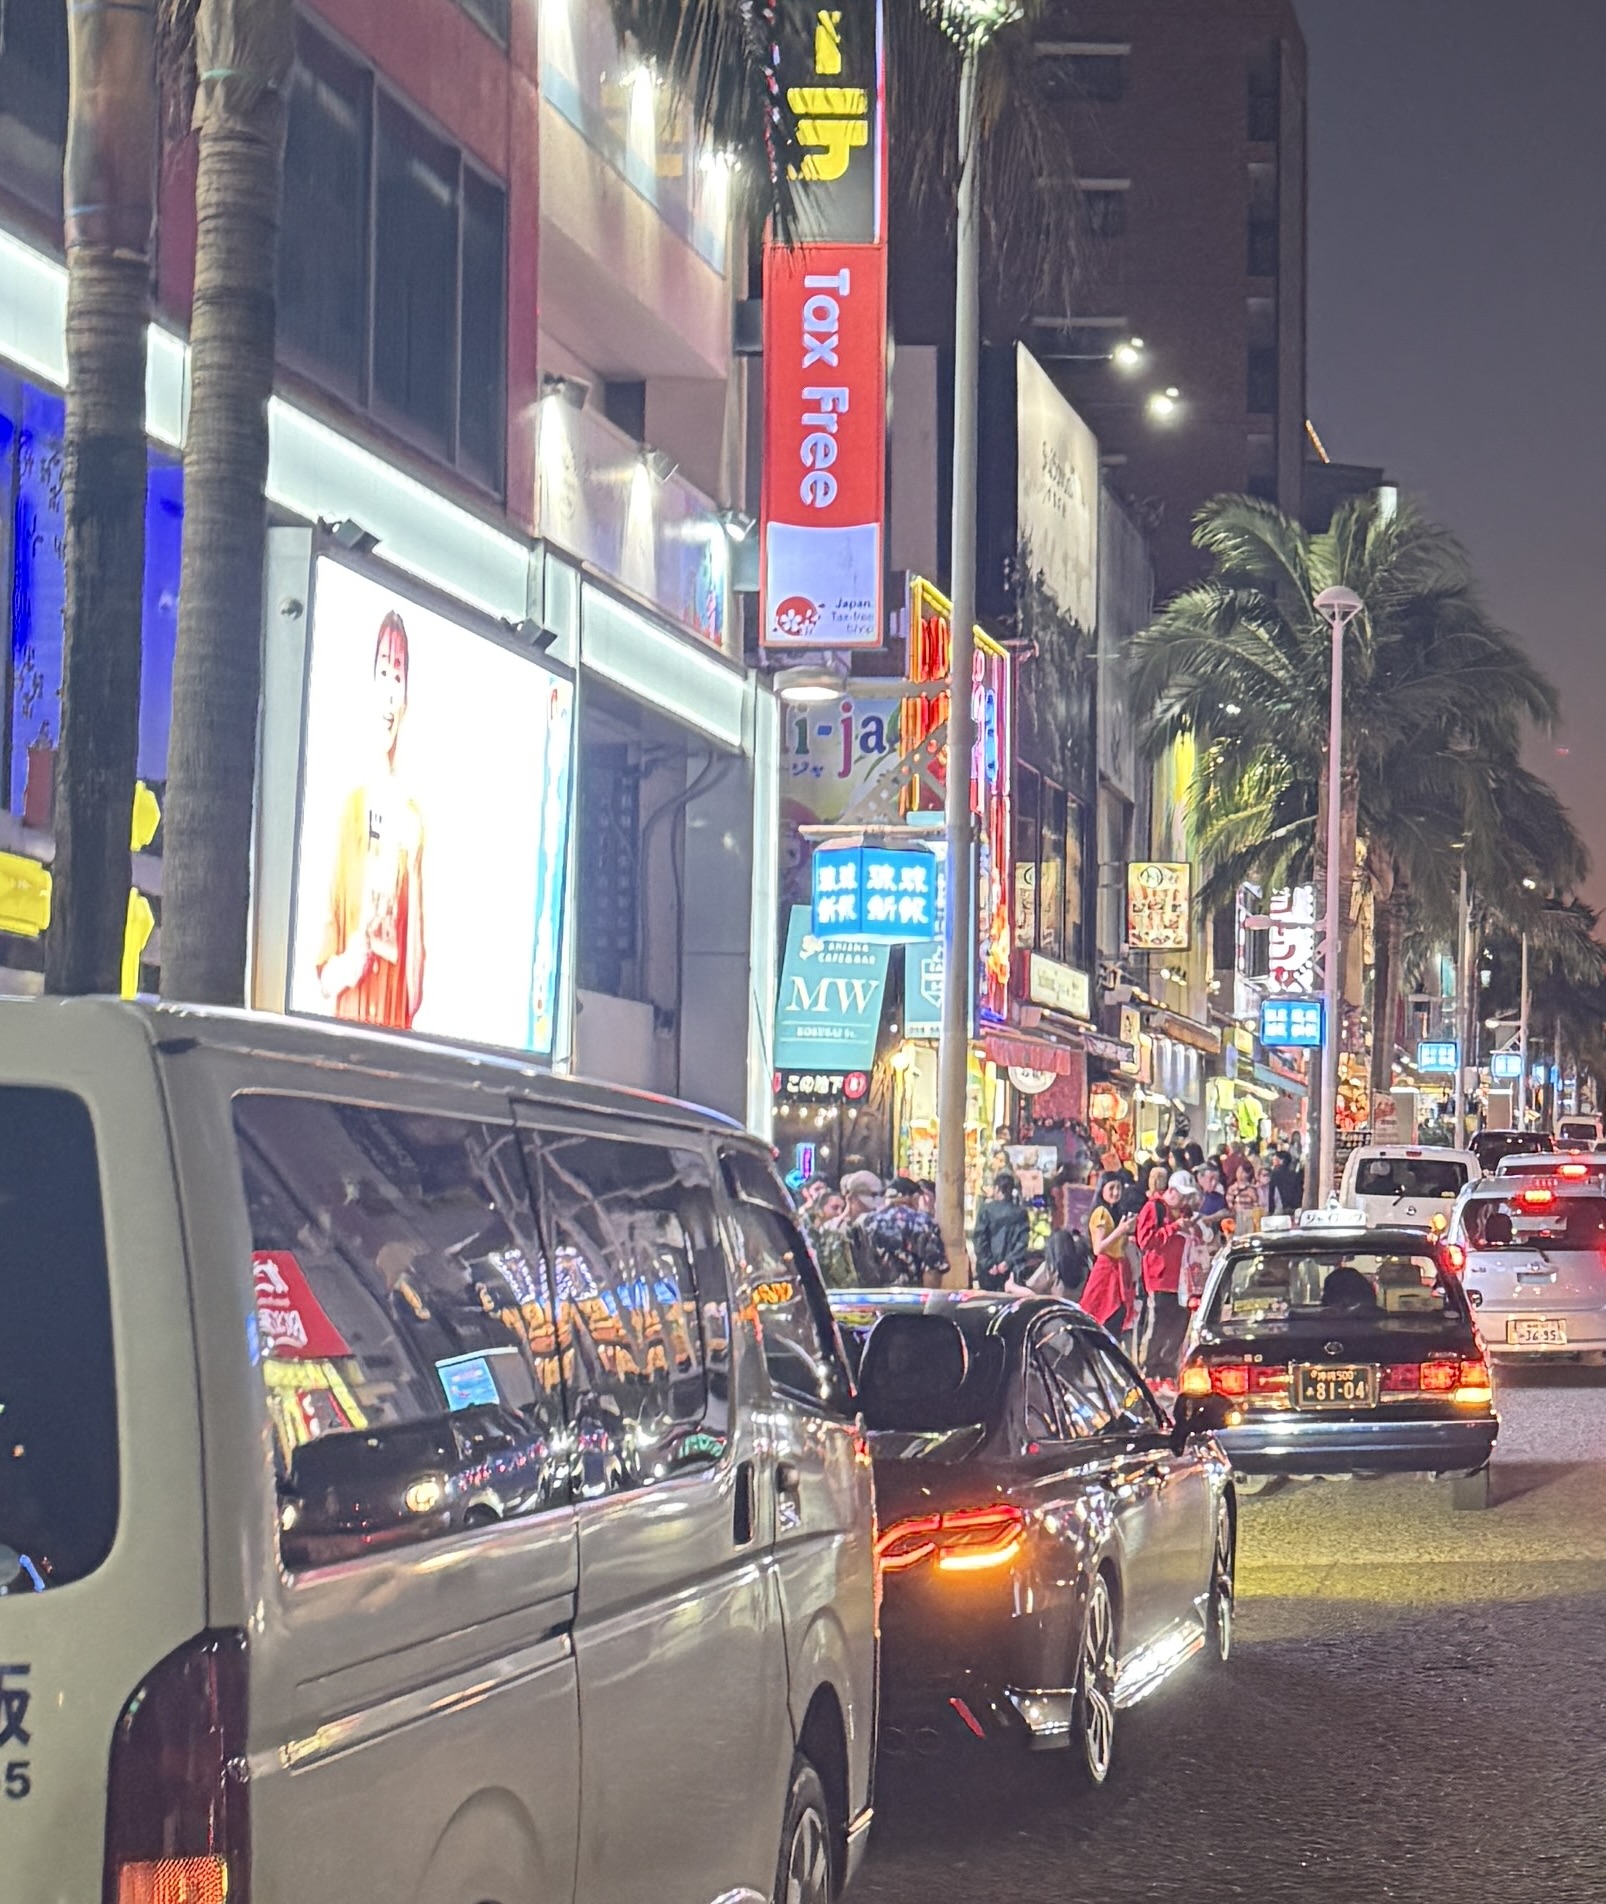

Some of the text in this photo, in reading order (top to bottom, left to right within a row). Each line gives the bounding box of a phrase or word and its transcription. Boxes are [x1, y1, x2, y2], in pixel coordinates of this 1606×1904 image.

[800, 269, 851, 509] Tax Free
[785, 976, 879, 1015] MW
